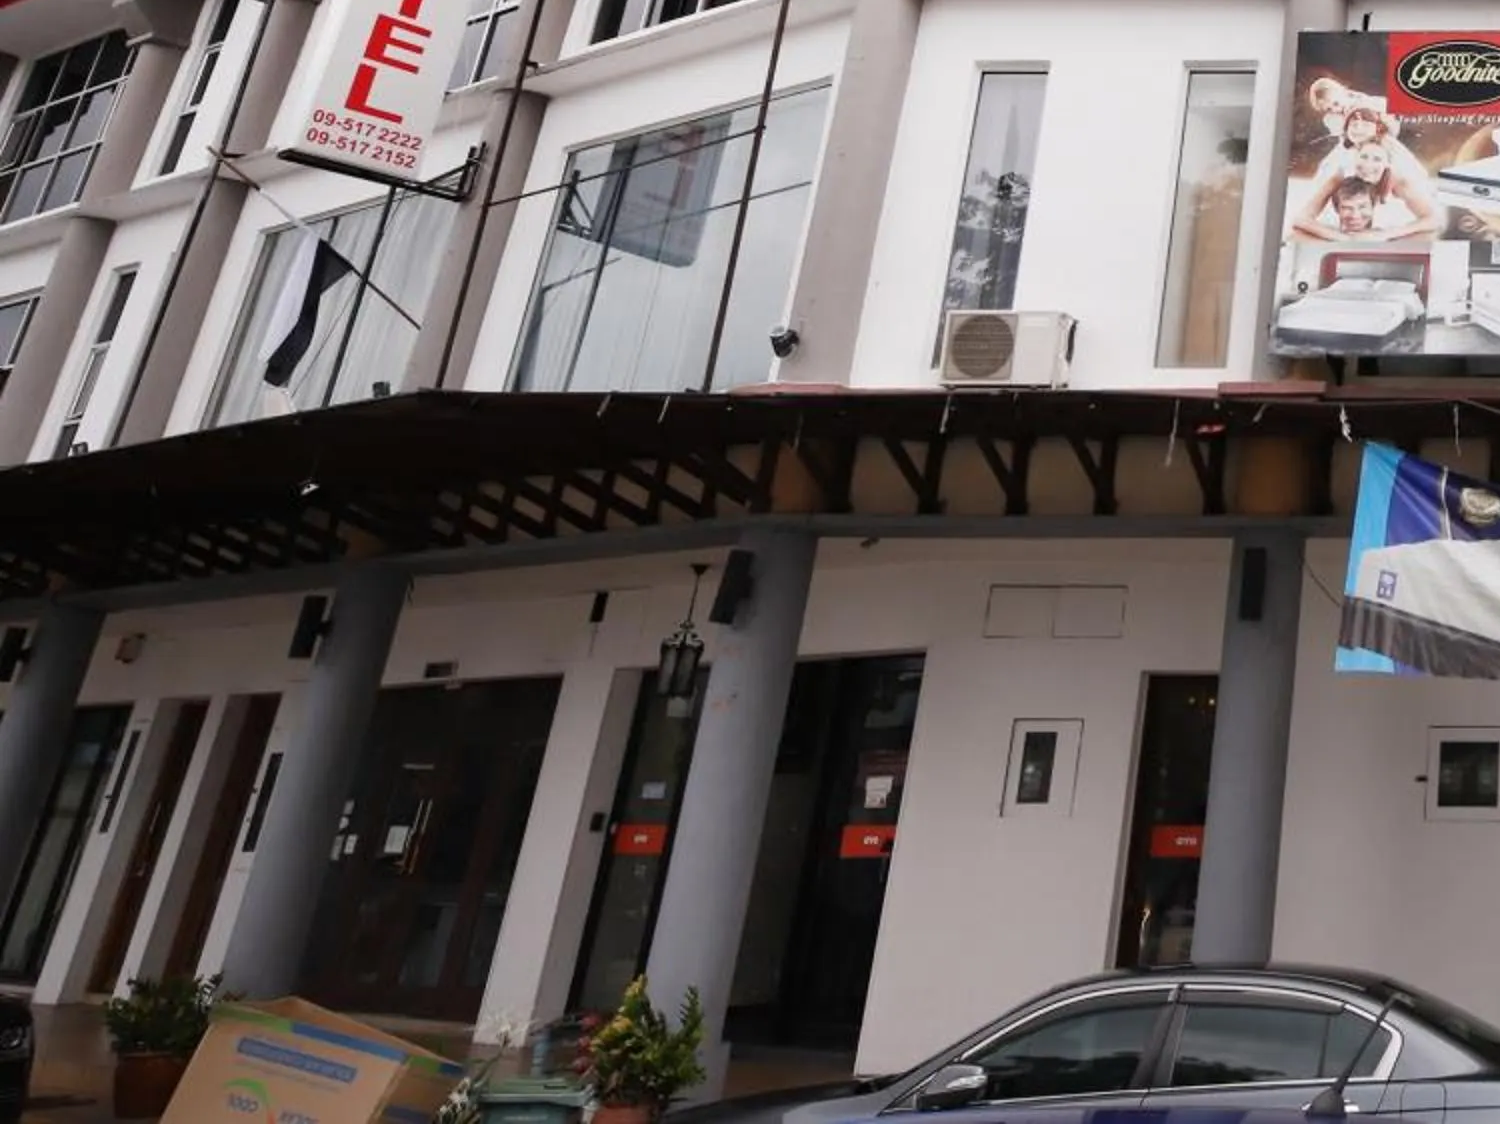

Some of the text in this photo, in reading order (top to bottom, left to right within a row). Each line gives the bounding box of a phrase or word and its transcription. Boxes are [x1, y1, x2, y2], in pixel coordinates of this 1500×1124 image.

[306, 127, 416, 169] 09-517 2152
[313, 109, 422, 151] 09-517 2222
